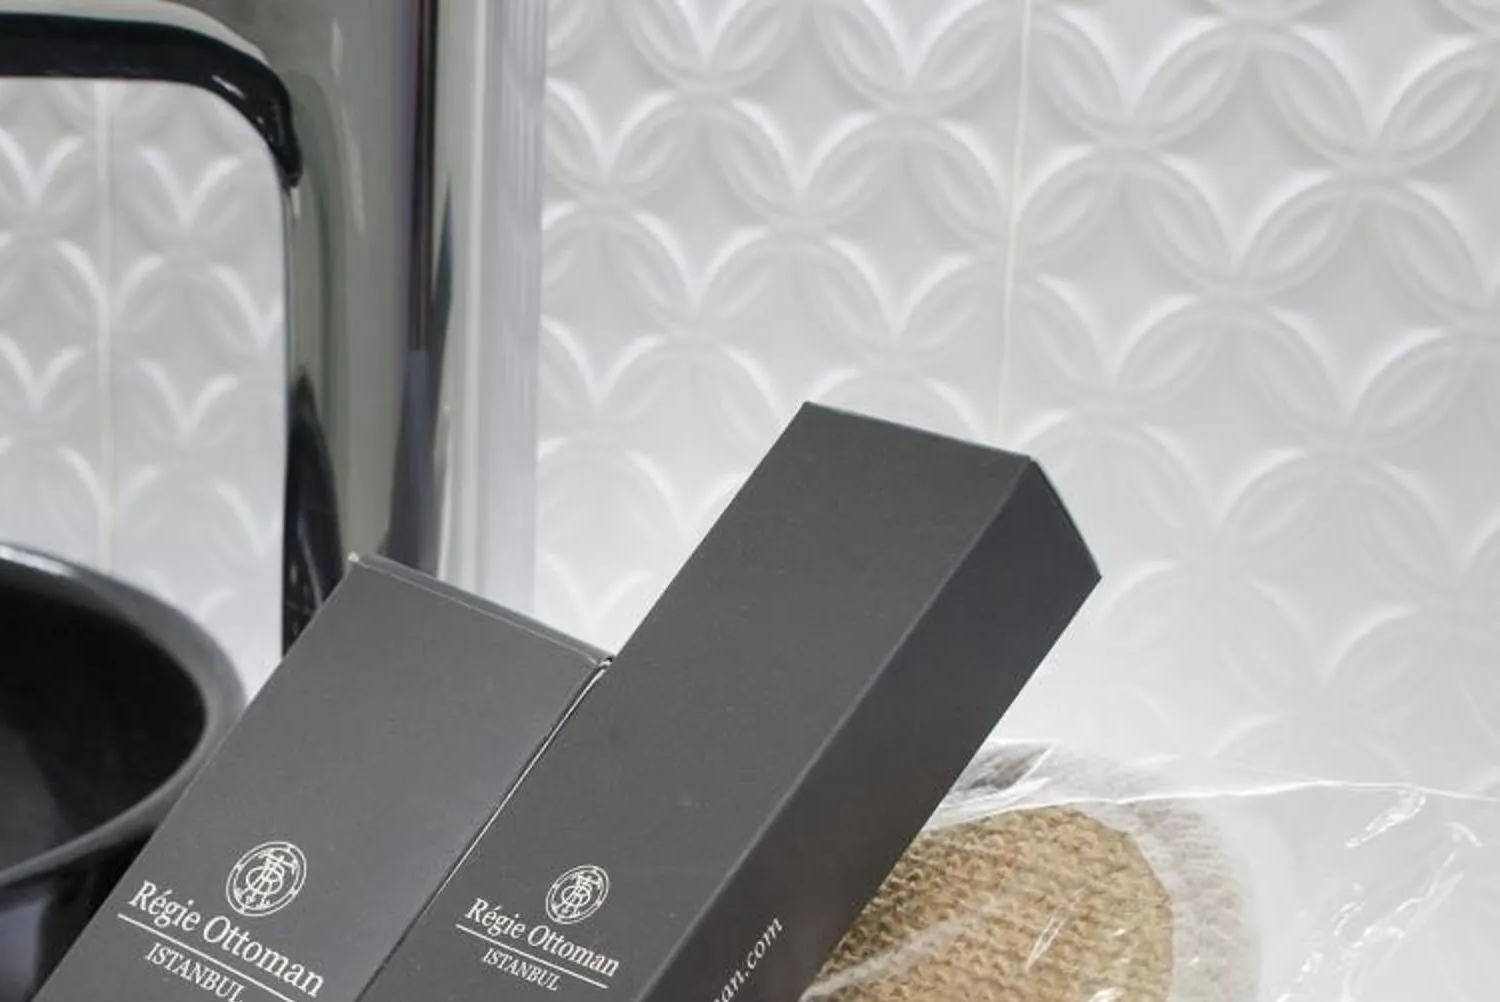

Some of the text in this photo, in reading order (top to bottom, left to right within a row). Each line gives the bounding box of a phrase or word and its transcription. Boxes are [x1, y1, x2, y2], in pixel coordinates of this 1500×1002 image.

[128, 880, 324, 998] Régie Ottoman
[465, 898, 620, 977] Régie Ottoman
[482, 948, 561, 991] ISTANBUL
